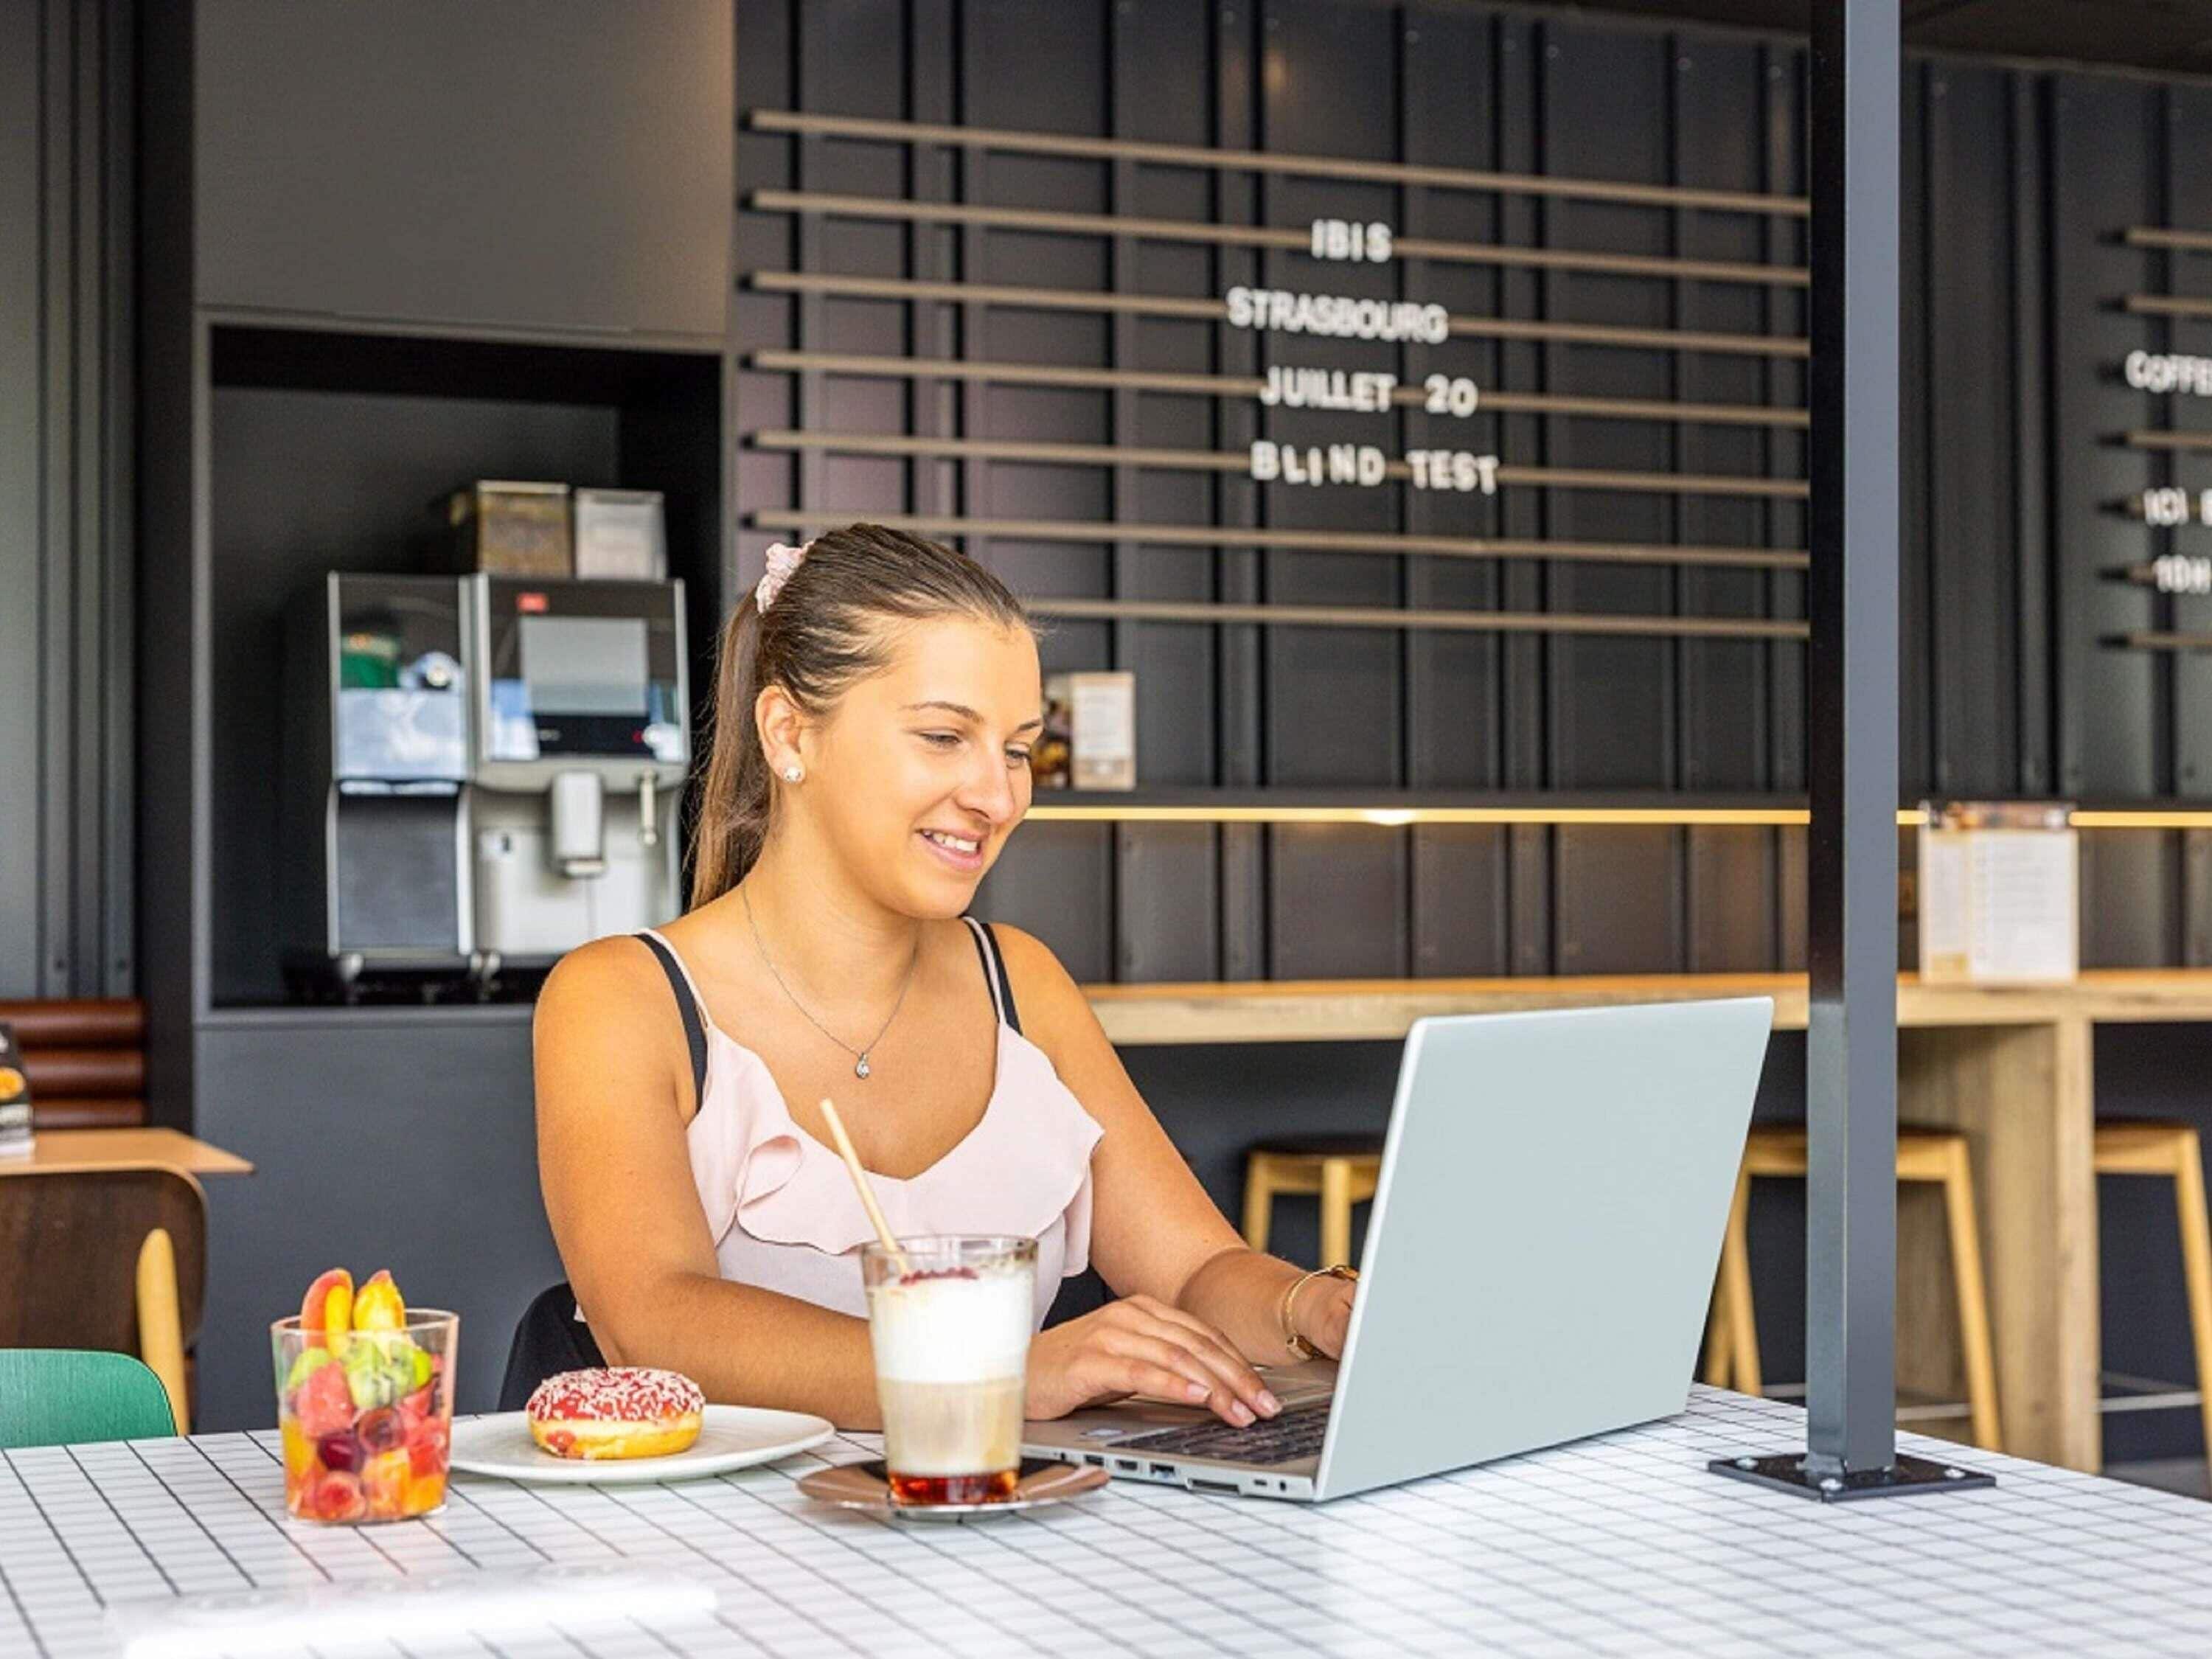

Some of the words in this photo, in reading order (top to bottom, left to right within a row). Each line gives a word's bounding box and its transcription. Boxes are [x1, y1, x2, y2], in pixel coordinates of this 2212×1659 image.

[1312, 219, 1391, 262] IBIS
[1226, 286, 1448, 343] STRASBOURG
[1259, 366, 1397, 412] JUILLET
[1425, 374, 1478, 417] 20
[1251, 441, 1385, 487] BLIND
[1405, 449, 1498, 494] TEST
